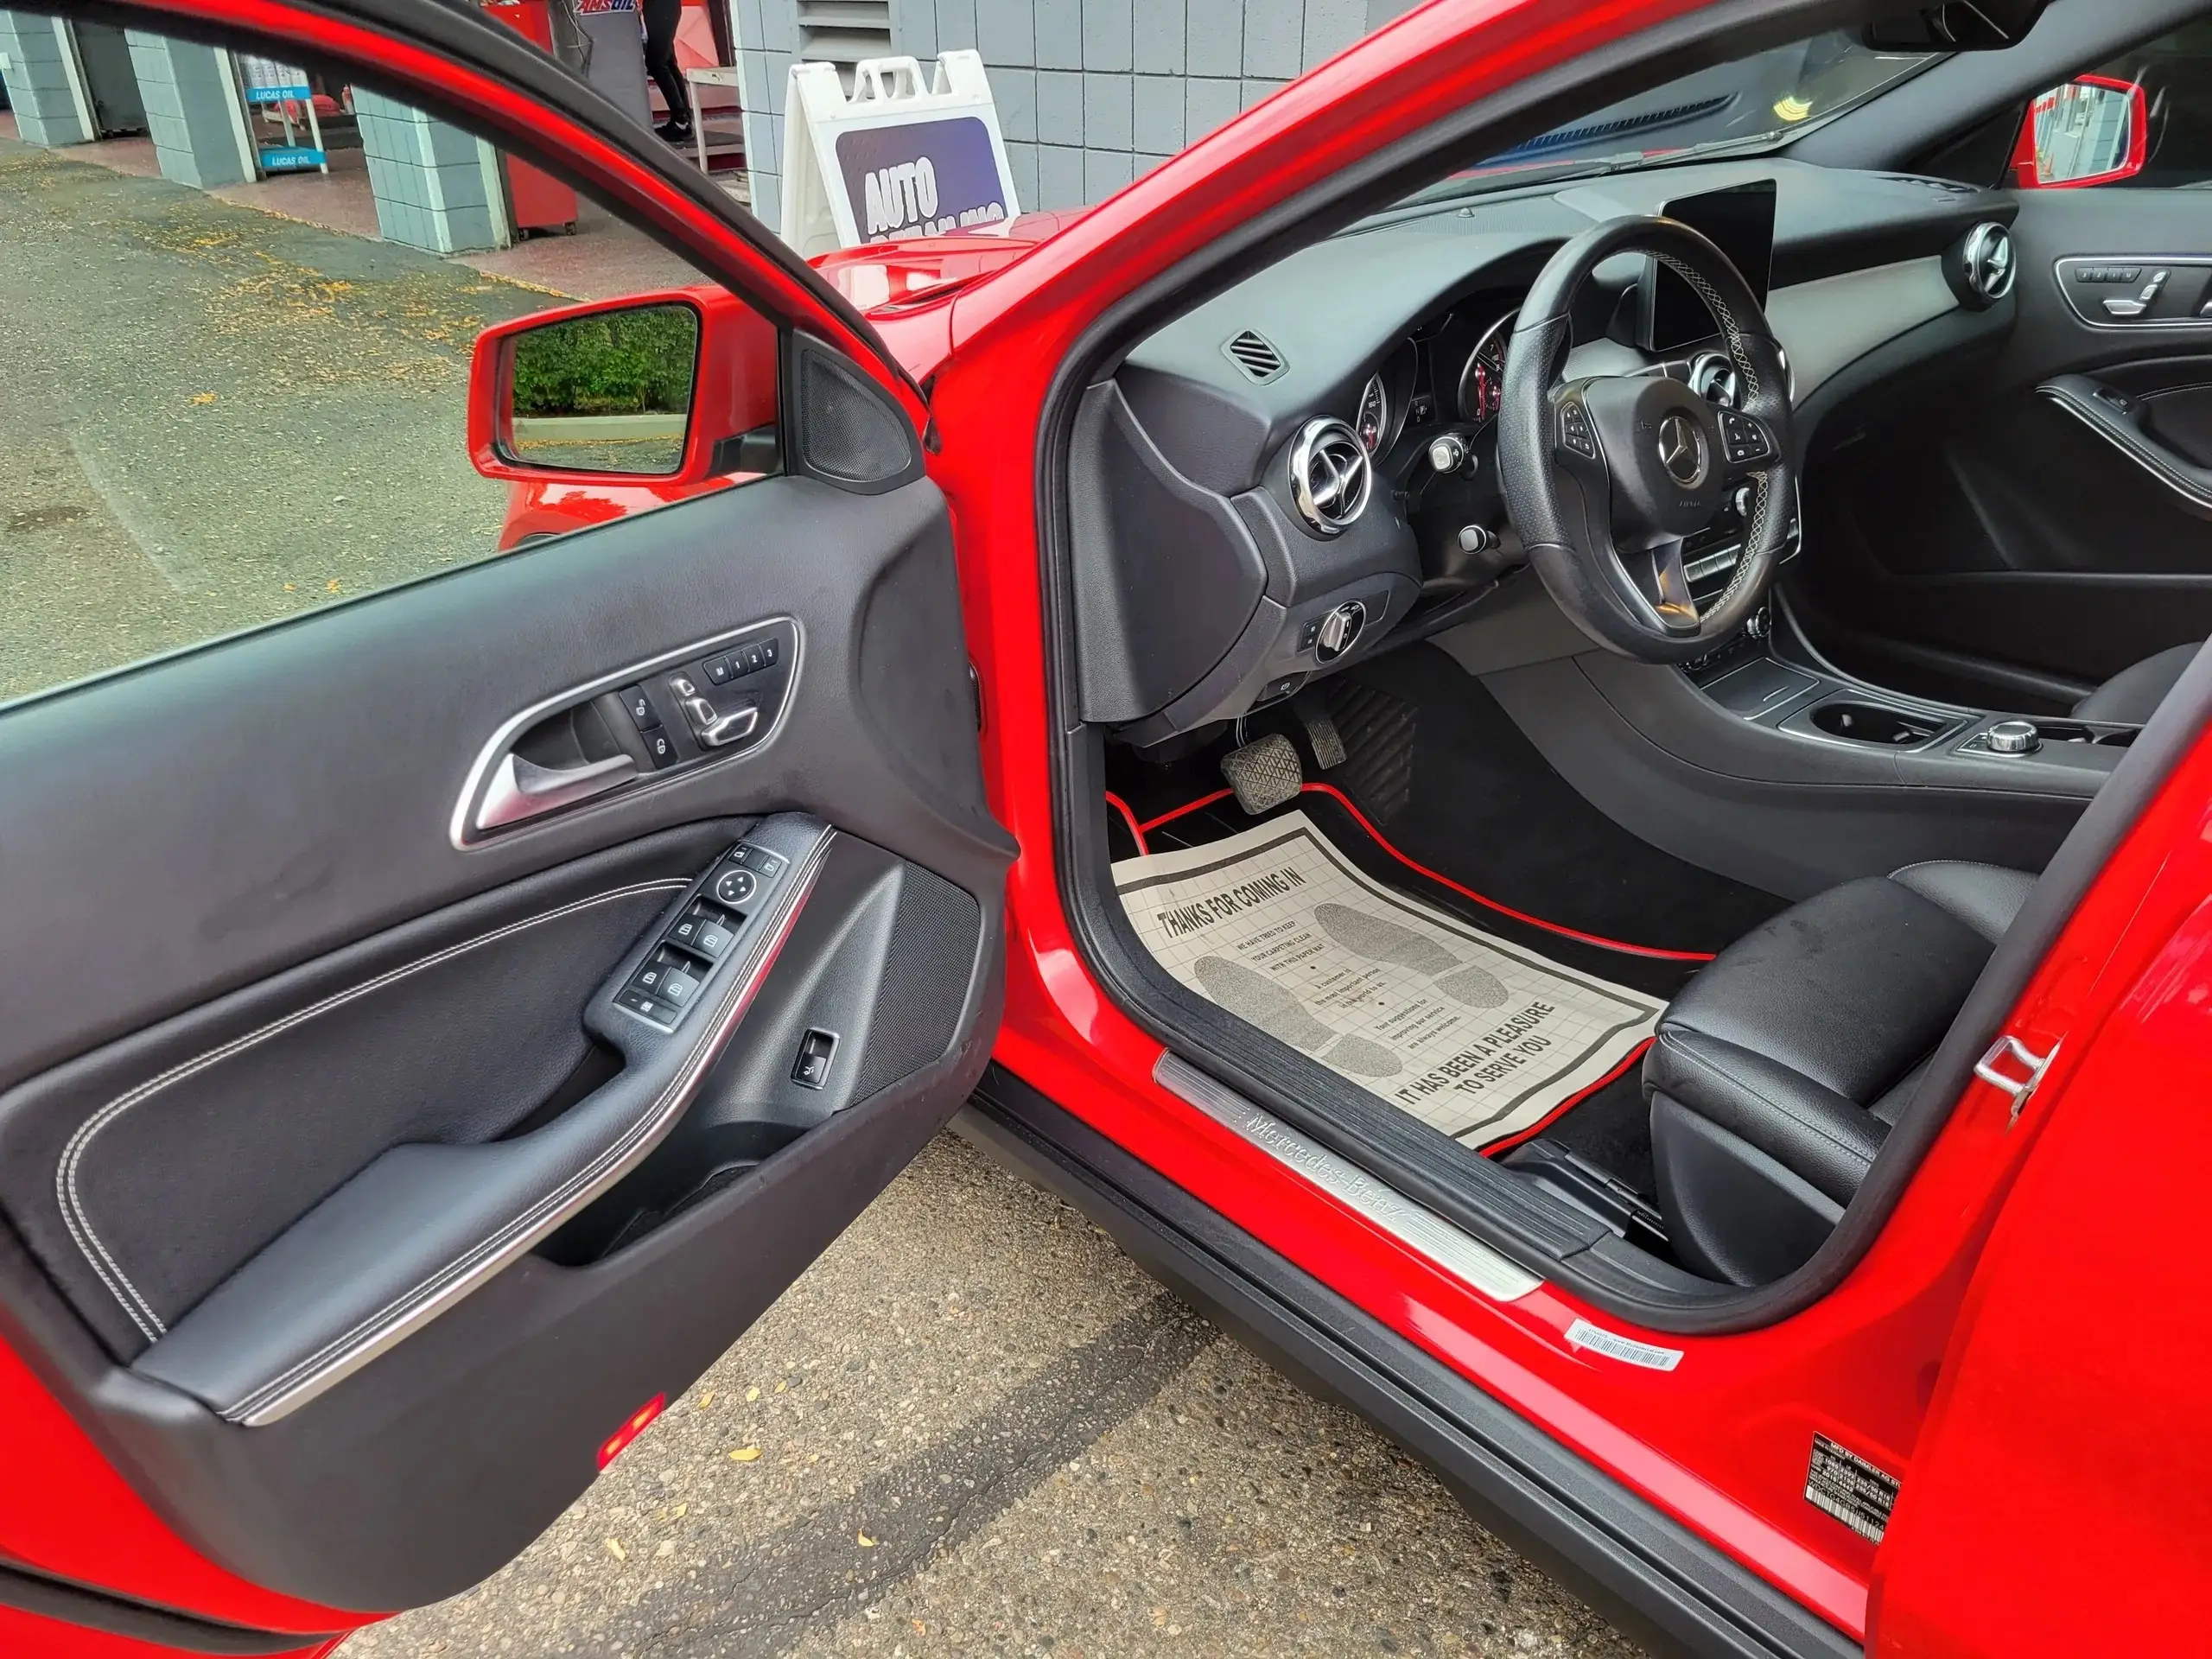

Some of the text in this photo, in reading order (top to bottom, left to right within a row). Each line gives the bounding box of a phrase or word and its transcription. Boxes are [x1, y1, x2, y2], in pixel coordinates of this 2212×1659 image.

[256, 90, 295, 100] LUCAS OIL
[271, 156, 311, 166] LUCAS OIL
[865, 156, 939, 235] AUTO
[715, 666, 725, 677] M
[751, 654, 758, 664] 2
[766, 649, 773, 658] 3
[1157, 866, 1307, 938] THANKS FOR COMING IN
[1236, 943, 1249, 951] WE
[1246, 937, 1262, 947] HAVE
[1258, 930, 1277, 941] TRIED
[1282, 920, 1296, 930] KEEP
[1250, 931, 1313, 962] YOUR CARPETING CLEAN
[1269, 943, 1325, 972] WITH THIS PAPER MAT
[1321, 971, 1346, 987] customer
[1325, 991, 1341, 1001] most
[1336, 976, 1365, 993] important
[1361, 968, 1382, 979] person
[1355, 988, 1372, 1002] world
[1373, 1021, 1390, 1031] Your
[1388, 1003, 1421, 1024] suggestions
[1388, 1006, 1446, 1041] improving our service
[1395, 1001, 1556, 1105] IT HAS BEEN A PLEASURE
[1407, 1041, 1420, 1050] are
[1416, 1029, 1438, 1044] always
[1452, 1034, 1552, 1095] TO SERVE YOU
[1245, 1112, 1408, 1223] Mercedes-Benz
[1844, 1451, 1853, 1459] BY
[1853, 1456, 1880, 1476] DAIMLER
[1879, 1471, 1890, 1482] AG
